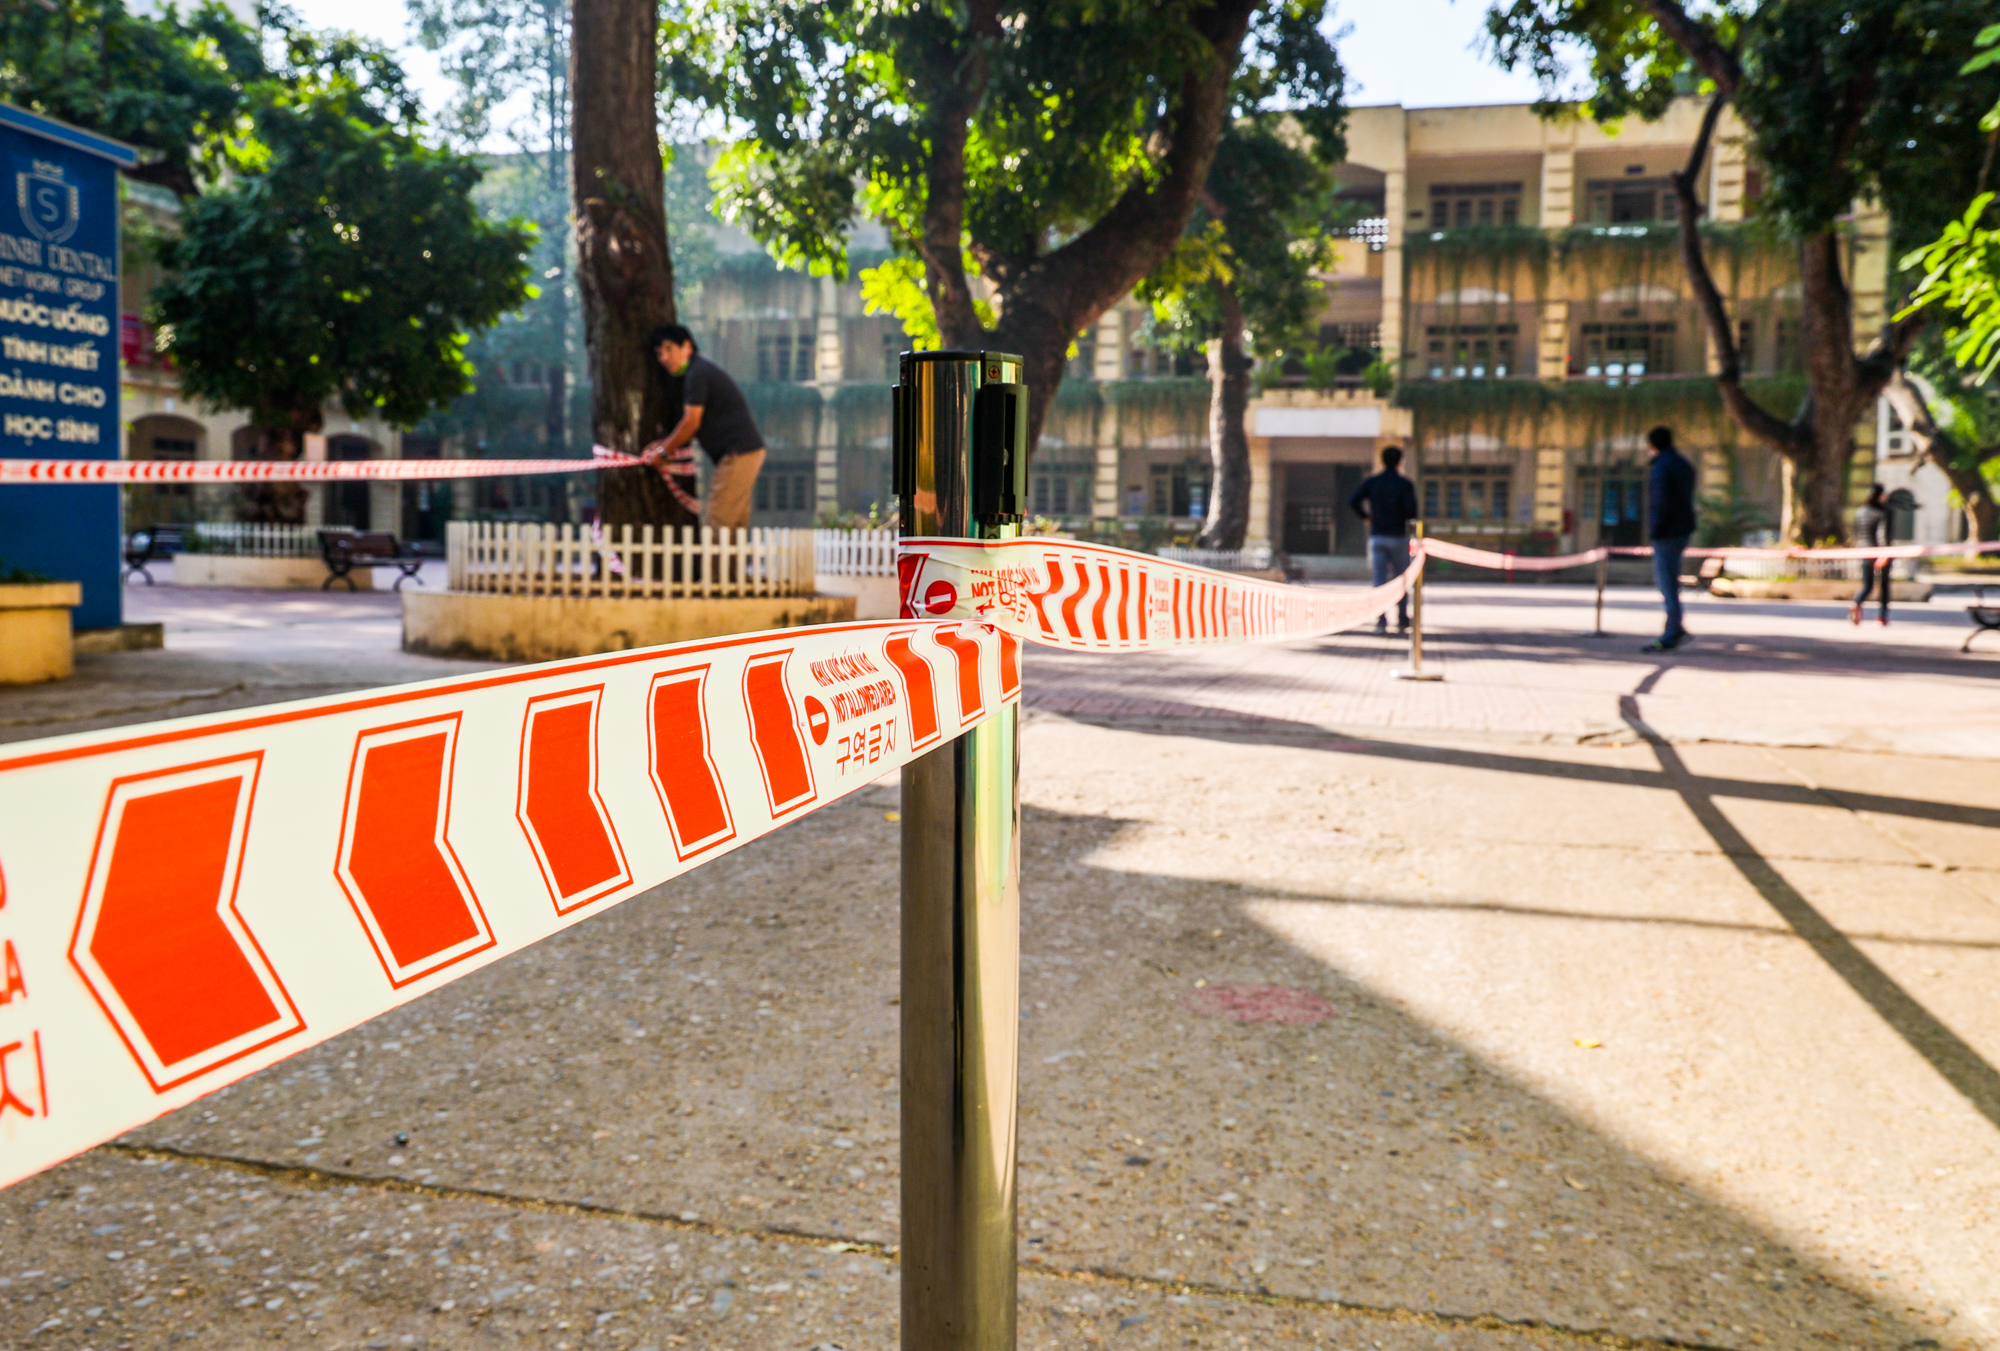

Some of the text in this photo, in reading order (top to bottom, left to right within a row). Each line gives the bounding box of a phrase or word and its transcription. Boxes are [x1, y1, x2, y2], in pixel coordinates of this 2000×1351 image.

[48, 243, 117, 282] DENTAL
[58, 382, 107, 409] CHO
[4, 412, 53, 446] HỌC
[971, 580, 995, 598] NOT
[829, 679, 897, 725] NOT ALLOWED AREA
